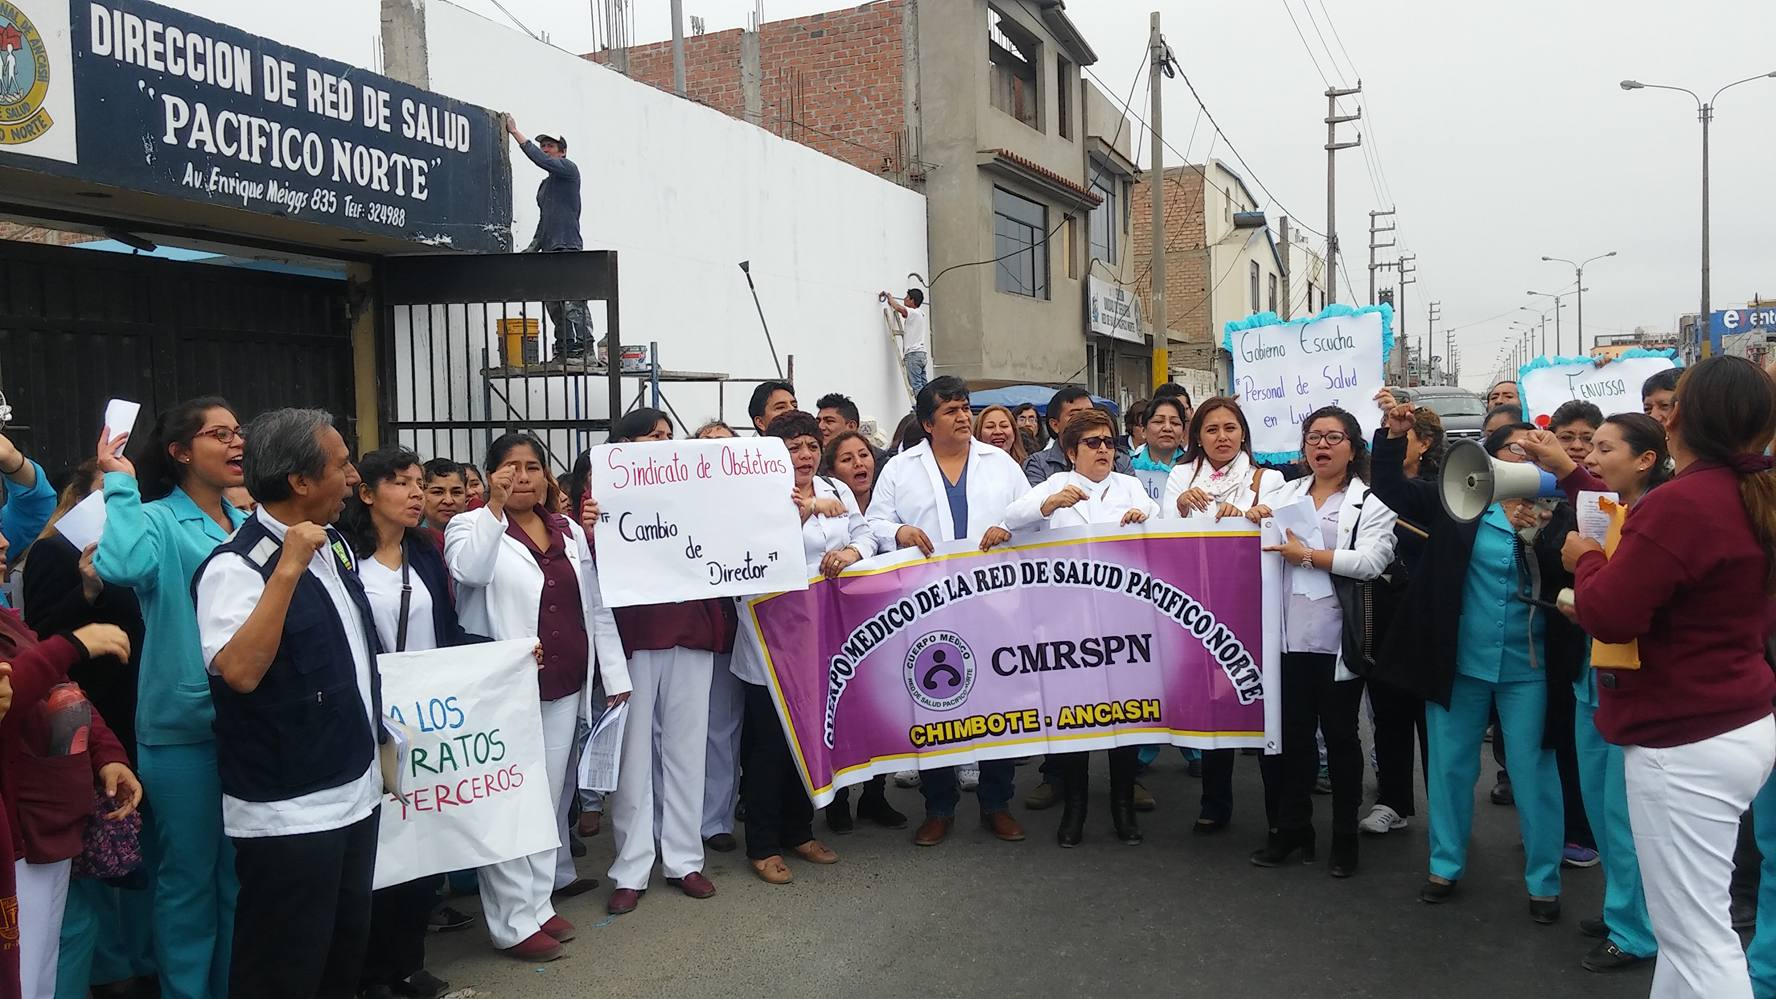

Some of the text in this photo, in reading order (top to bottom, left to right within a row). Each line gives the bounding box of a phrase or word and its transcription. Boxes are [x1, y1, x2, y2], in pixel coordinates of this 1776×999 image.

[90, 2, 470, 153] DIRECCION DE RED DE SALUD
[10, 114, 48, 141] NORTE
[182, 161, 203, 189] Av.
[208, 166, 264, 206] Enrique
[266, 179, 309, 214] Meiggs
[310, 188, 337, 214] 835
[368, 202, 406, 228] 324988
[1240, 322, 1356, 363] Gobierno Escucha
[1296, 375, 1309, 395] de
[1323, 364, 1357, 390] Salud
[1264, 414, 1278, 428] en
[608, 445, 787, 489] Sindicato de Obstetras
[685, 535, 703, 559] de
[844, 600, 915, 664] MEDICO
[915, 584, 945, 615] DE
[944, 574, 972, 602] LA
[974, 563, 1017, 593] RED
[1020, 561, 1049, 585] DE
[1053, 561, 1123, 590] SALUD
[1125, 571, 1212, 635] PACIFICO
[1206, 627, 1264, 702] NORTE
[906, 633, 971, 669] CUERPO MEDICO
[990, 633, 1152, 677] CMRSPN
[416, 696, 465, 732] LOS
[913, 690, 922, 700] DE
[920, 697, 941, 708] SALUD
[909, 708, 1040, 748] CHIMBOTE
[1058, 700, 1162, 729] ANCASH
[411, 729, 506, 778] RATOS
[390, 763, 525, 820] TERCEROS
